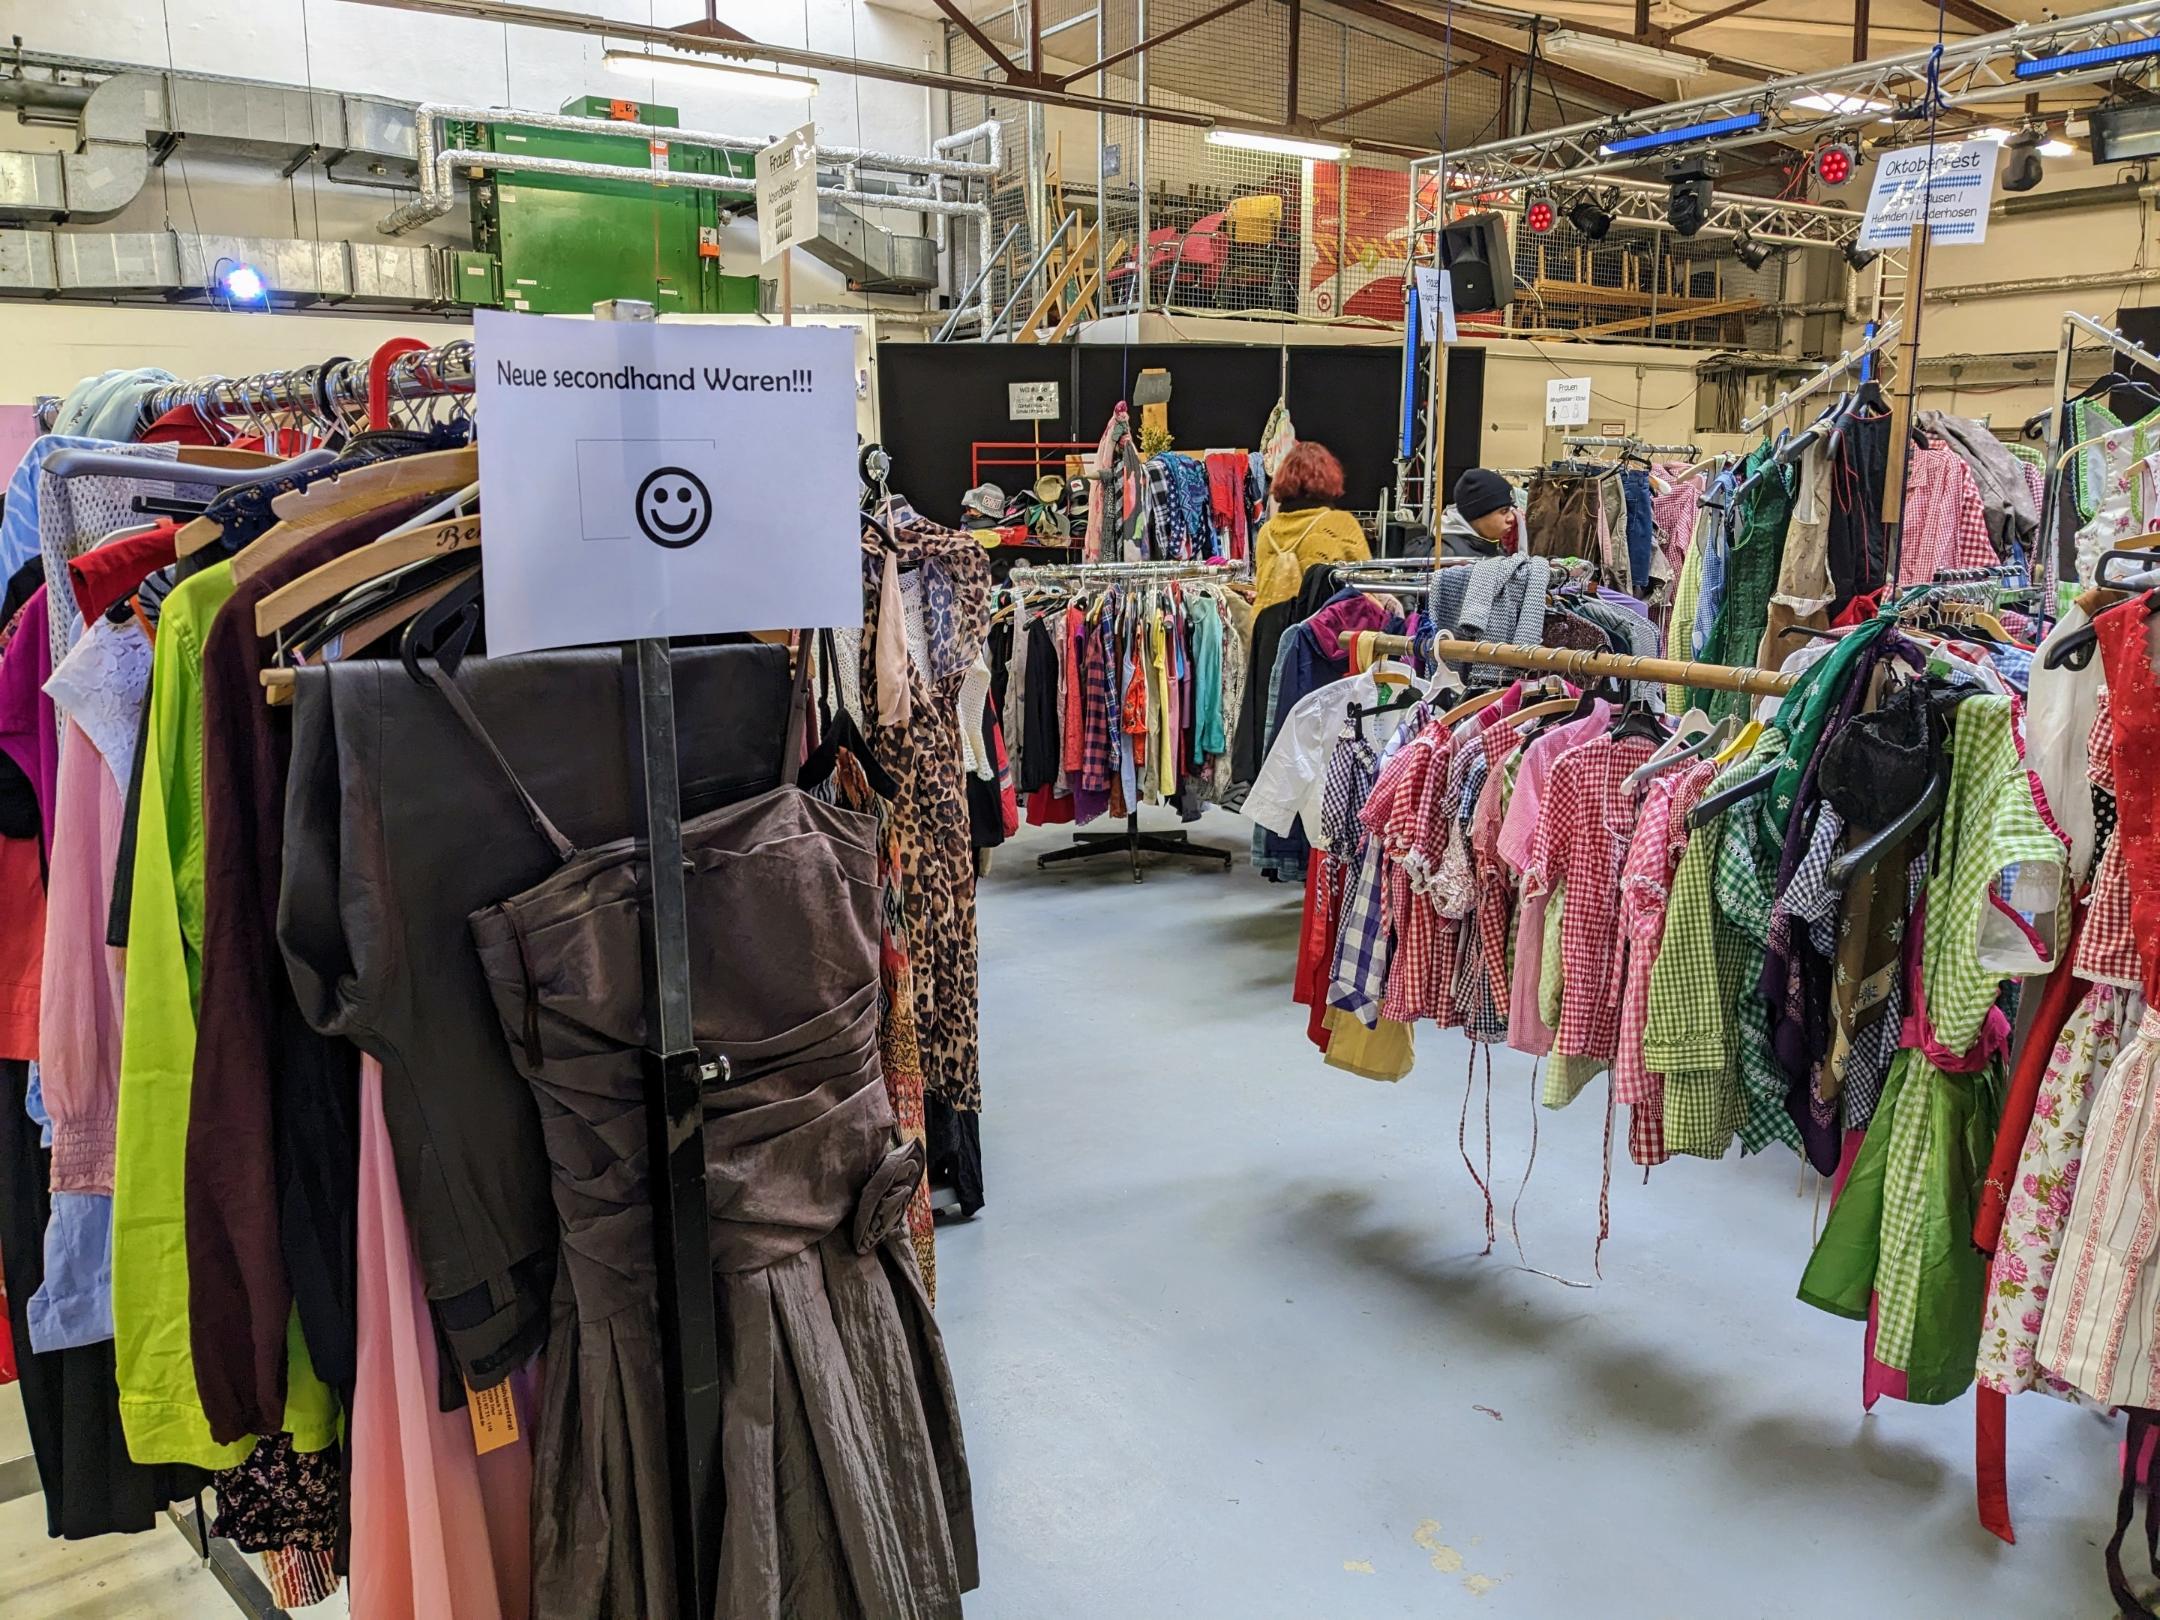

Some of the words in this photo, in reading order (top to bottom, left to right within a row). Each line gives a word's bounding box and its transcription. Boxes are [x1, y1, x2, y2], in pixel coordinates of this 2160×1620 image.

[769, 147, 794, 173] Frauen
[1871, 211, 1907, 224] Hemden
[1916, 208, 1978, 221] Lederhosen
[497, 360, 547, 388] Neue
[554, 366, 696, 391] secondhand
[703, 367, 813, 393] Waren!!!
